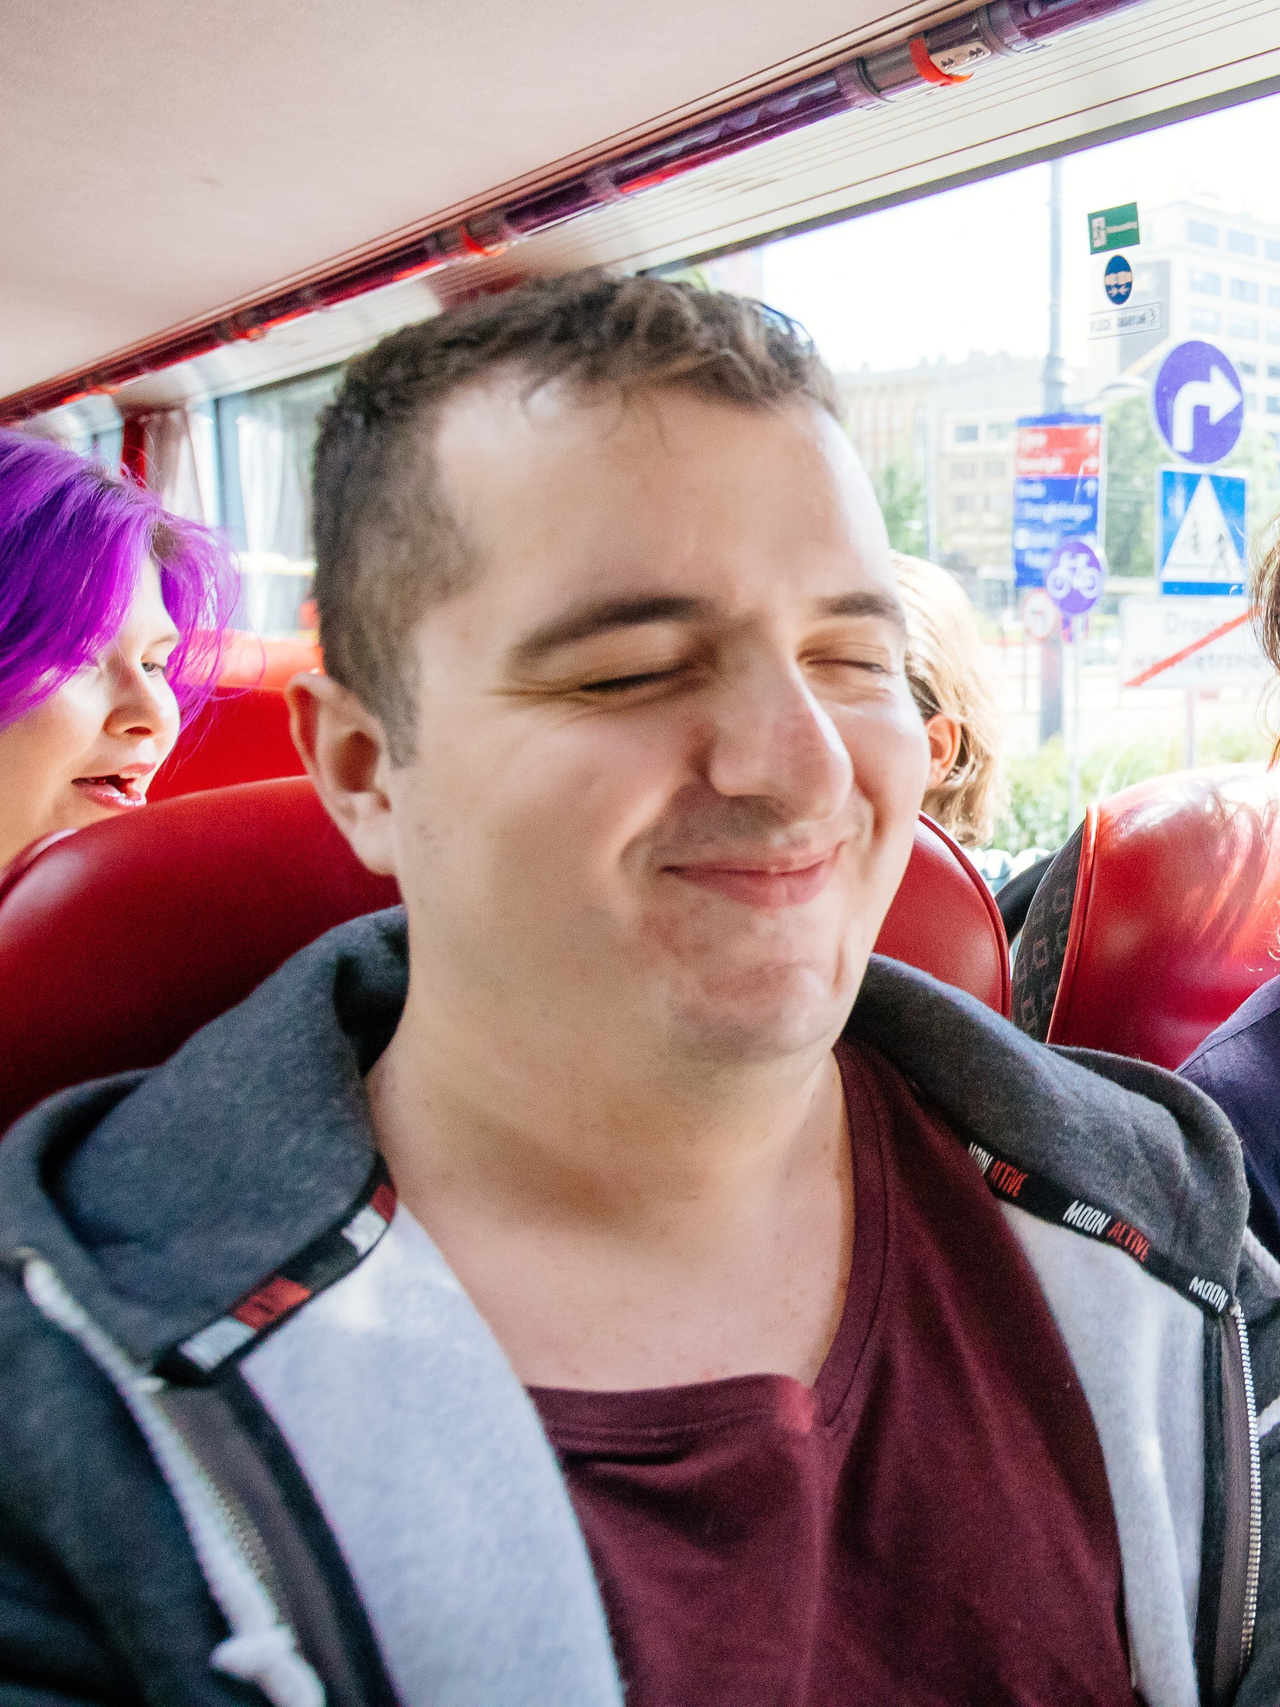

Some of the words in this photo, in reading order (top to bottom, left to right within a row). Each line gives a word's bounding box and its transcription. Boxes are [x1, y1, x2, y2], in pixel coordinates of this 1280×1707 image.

[1062, 1200, 1112, 1235] MOON
[1107, 1221, 1151, 1263] ACTIVE
[1189, 1276, 1228, 1313] MOON
